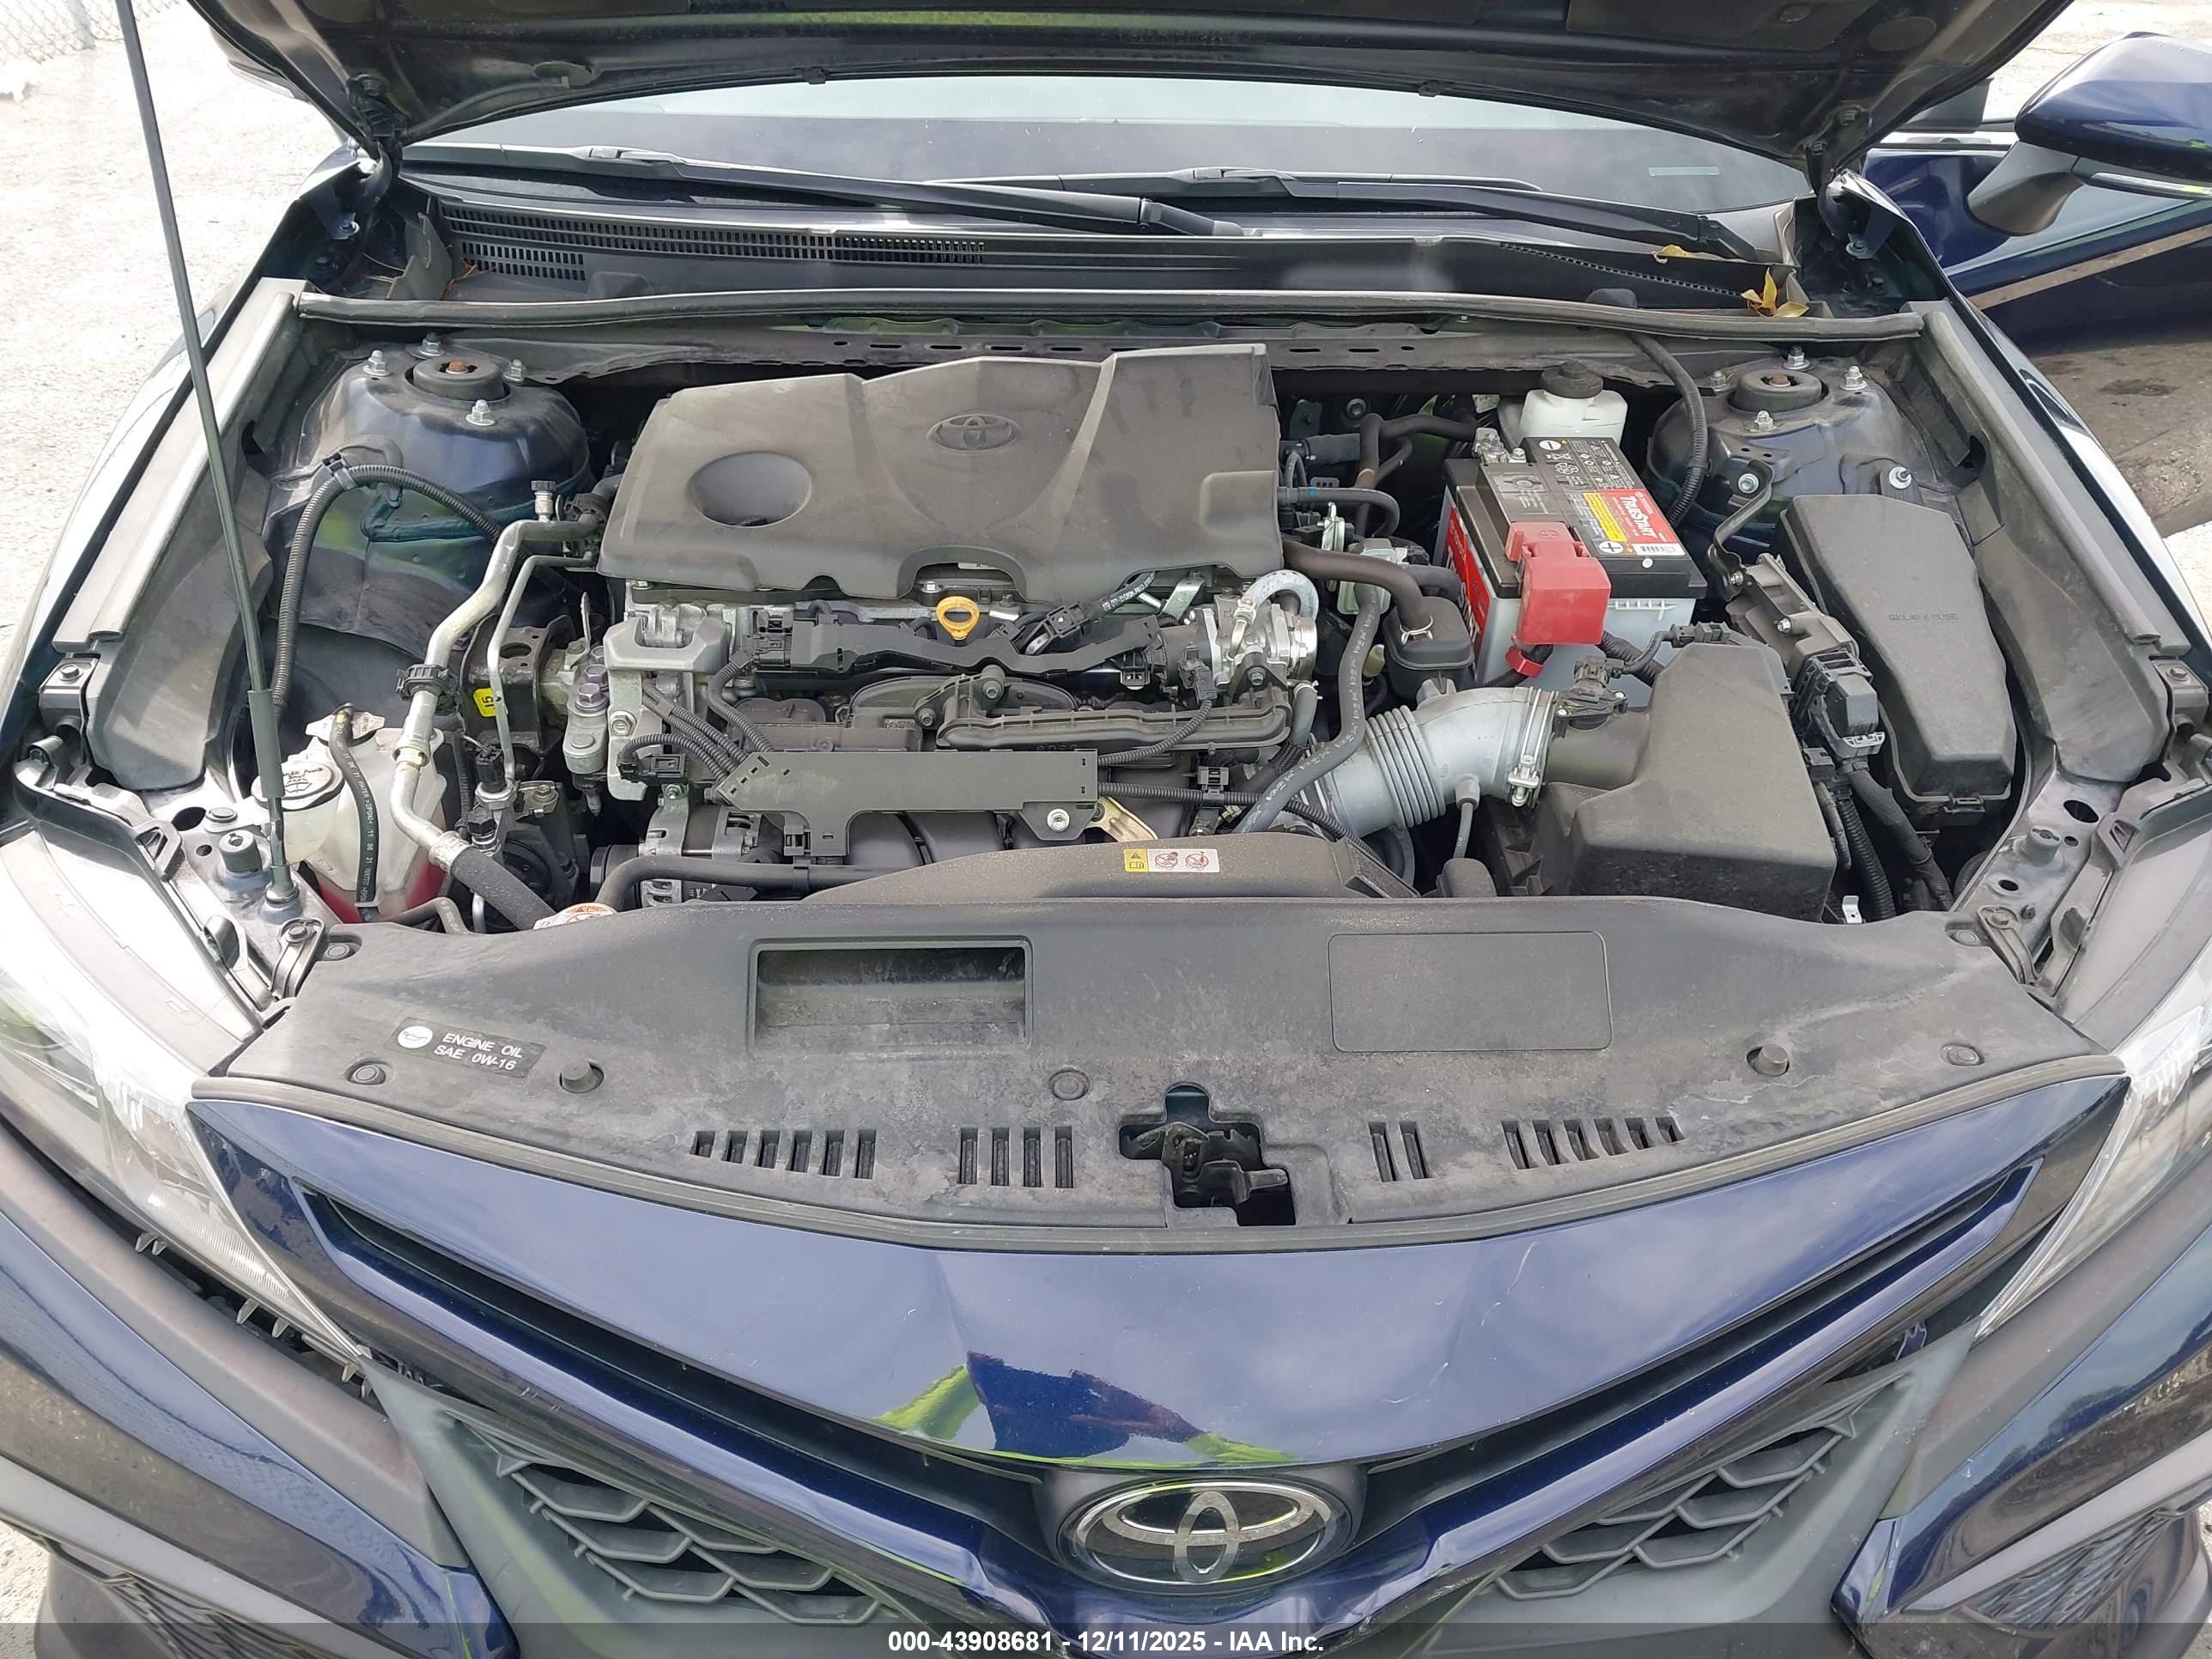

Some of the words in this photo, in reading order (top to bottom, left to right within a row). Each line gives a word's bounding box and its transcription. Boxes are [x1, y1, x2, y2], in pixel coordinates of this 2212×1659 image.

[357, 779, 370, 799] WATER
[434, 1045, 465, 1059] SAE
[471, 1053, 517, 1070] 0W-16
[441, 1033, 495, 1052] ENGINE
[501, 1045, 523, 1058] OIL
